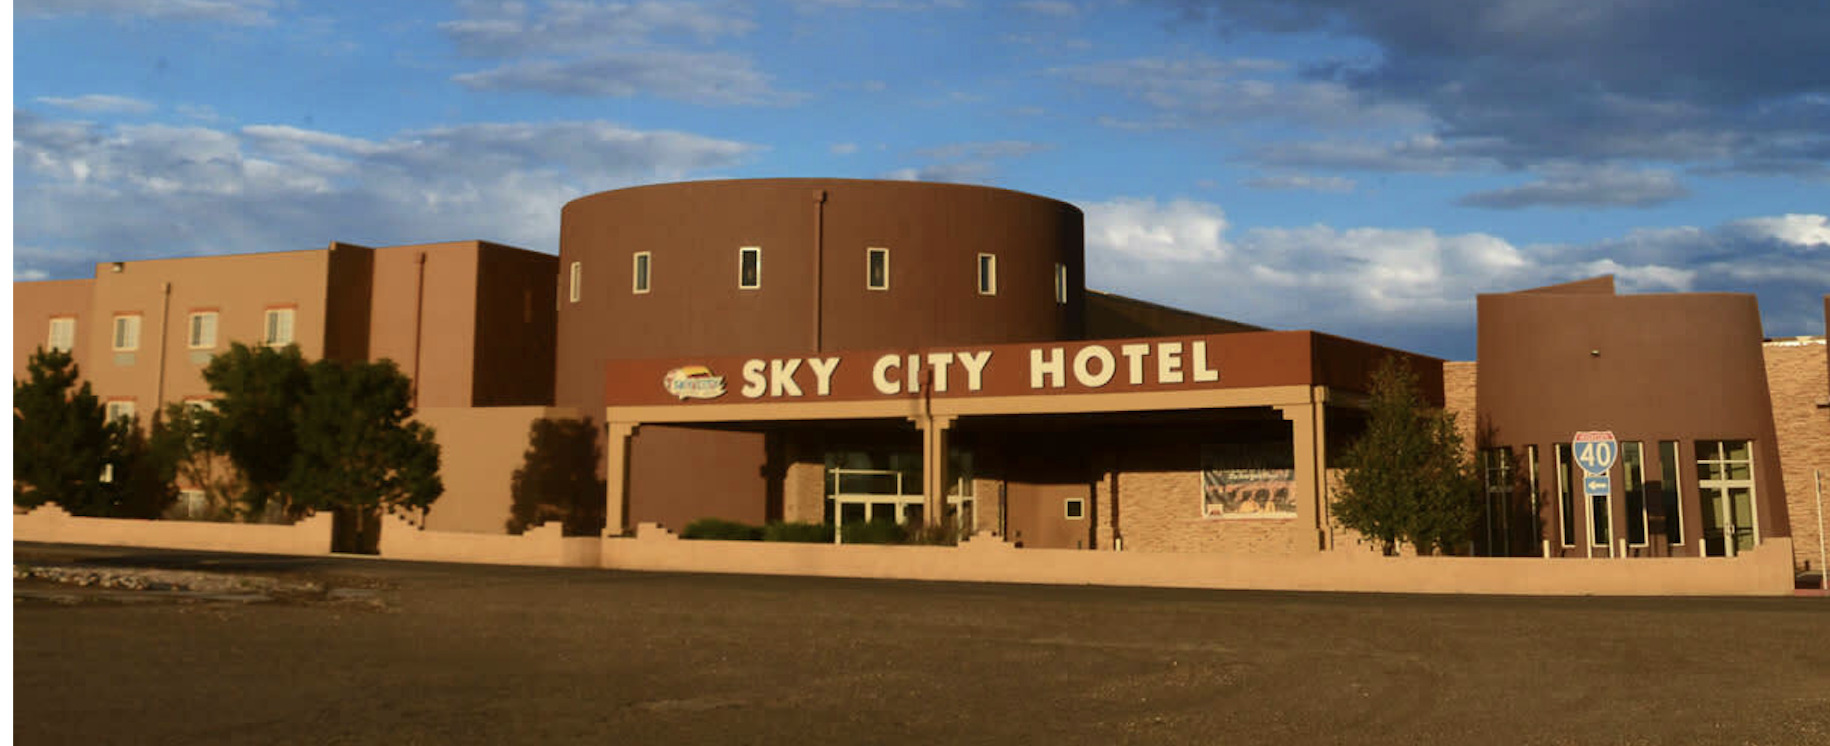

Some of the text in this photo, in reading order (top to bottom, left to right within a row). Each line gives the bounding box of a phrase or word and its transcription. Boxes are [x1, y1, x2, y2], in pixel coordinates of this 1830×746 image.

[741, 341, 1219, 398] SKY CITY HOTEL
[1580, 442, 1611, 467] 40
